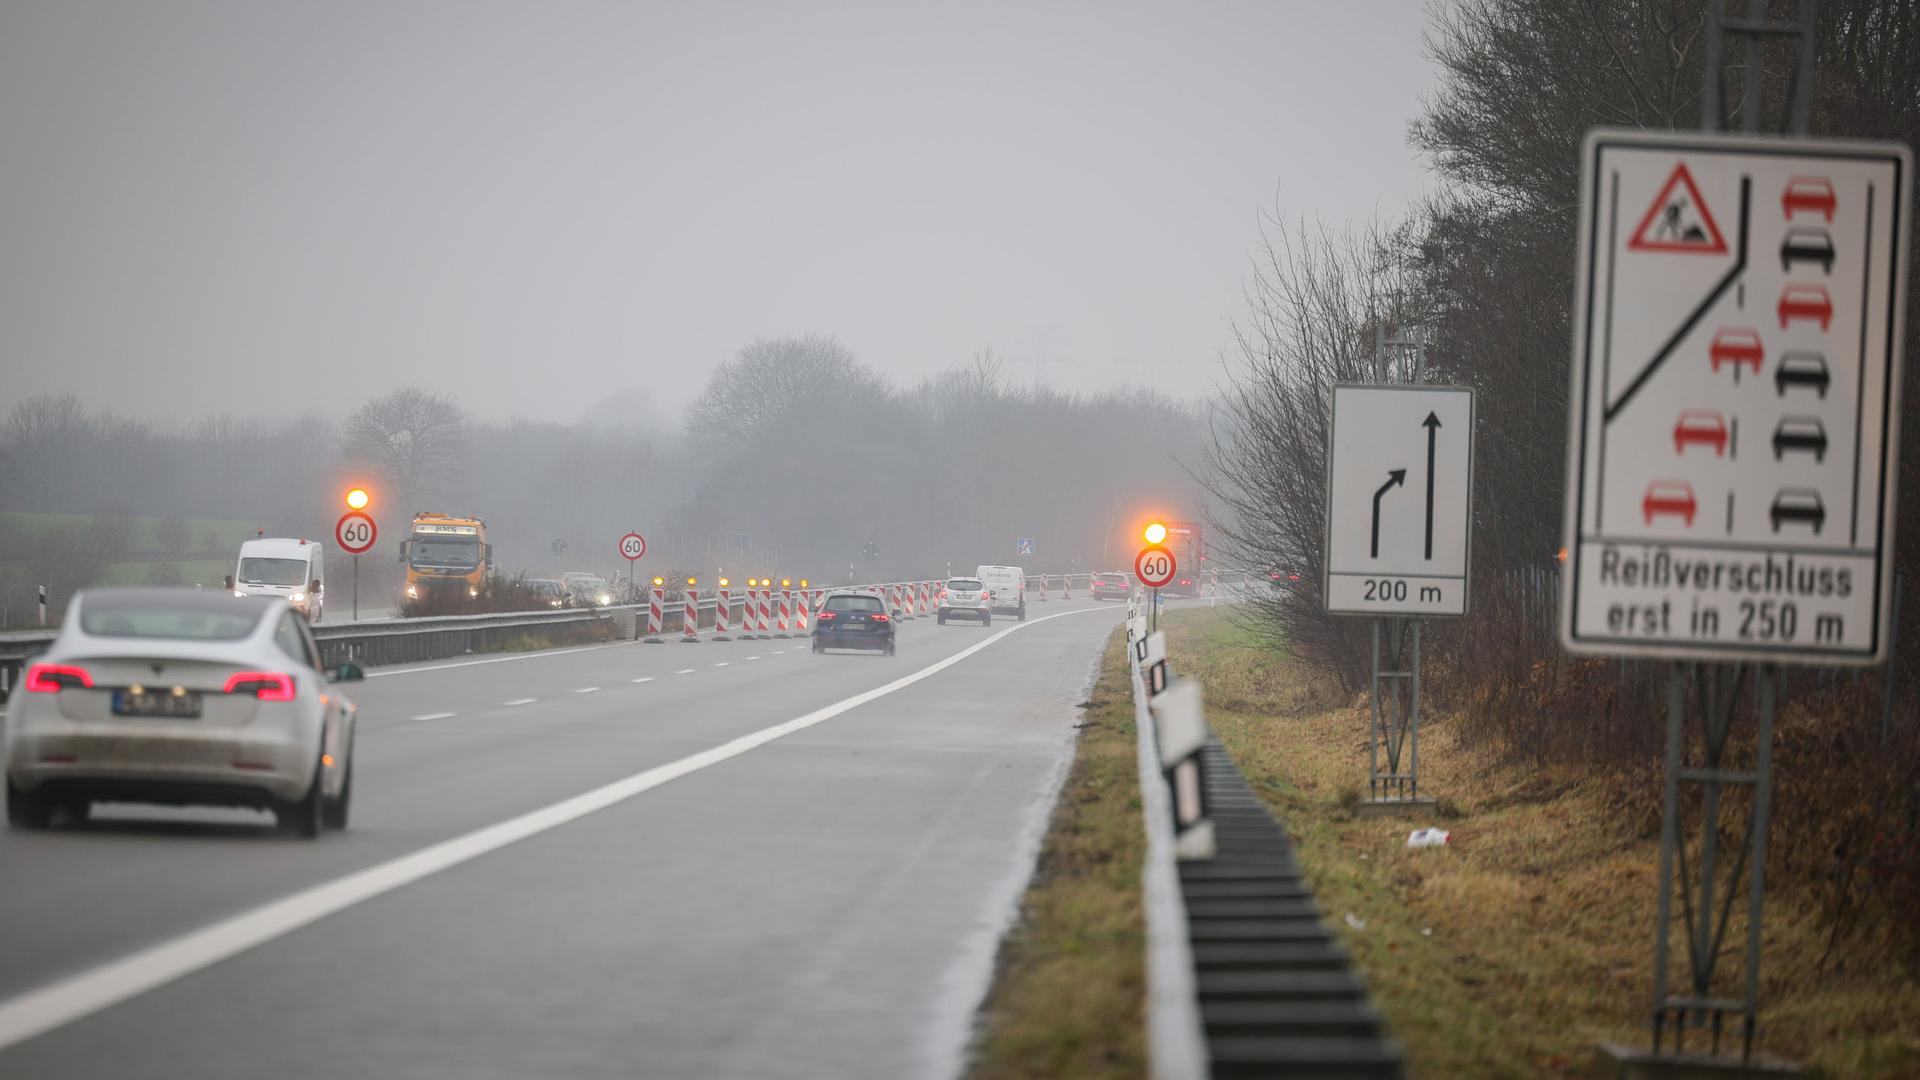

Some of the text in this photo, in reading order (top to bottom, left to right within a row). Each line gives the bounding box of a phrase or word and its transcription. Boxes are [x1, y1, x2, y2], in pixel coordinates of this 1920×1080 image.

[345, 523, 368, 542] 60
[625, 540, 640, 553] 60
[1144, 557, 1167, 576] 60
[1601, 548, 1853, 598] Reißverschluss
[1364, 579, 1441, 603] 200 m
[1607, 598, 1845, 643] erst in 250 m
